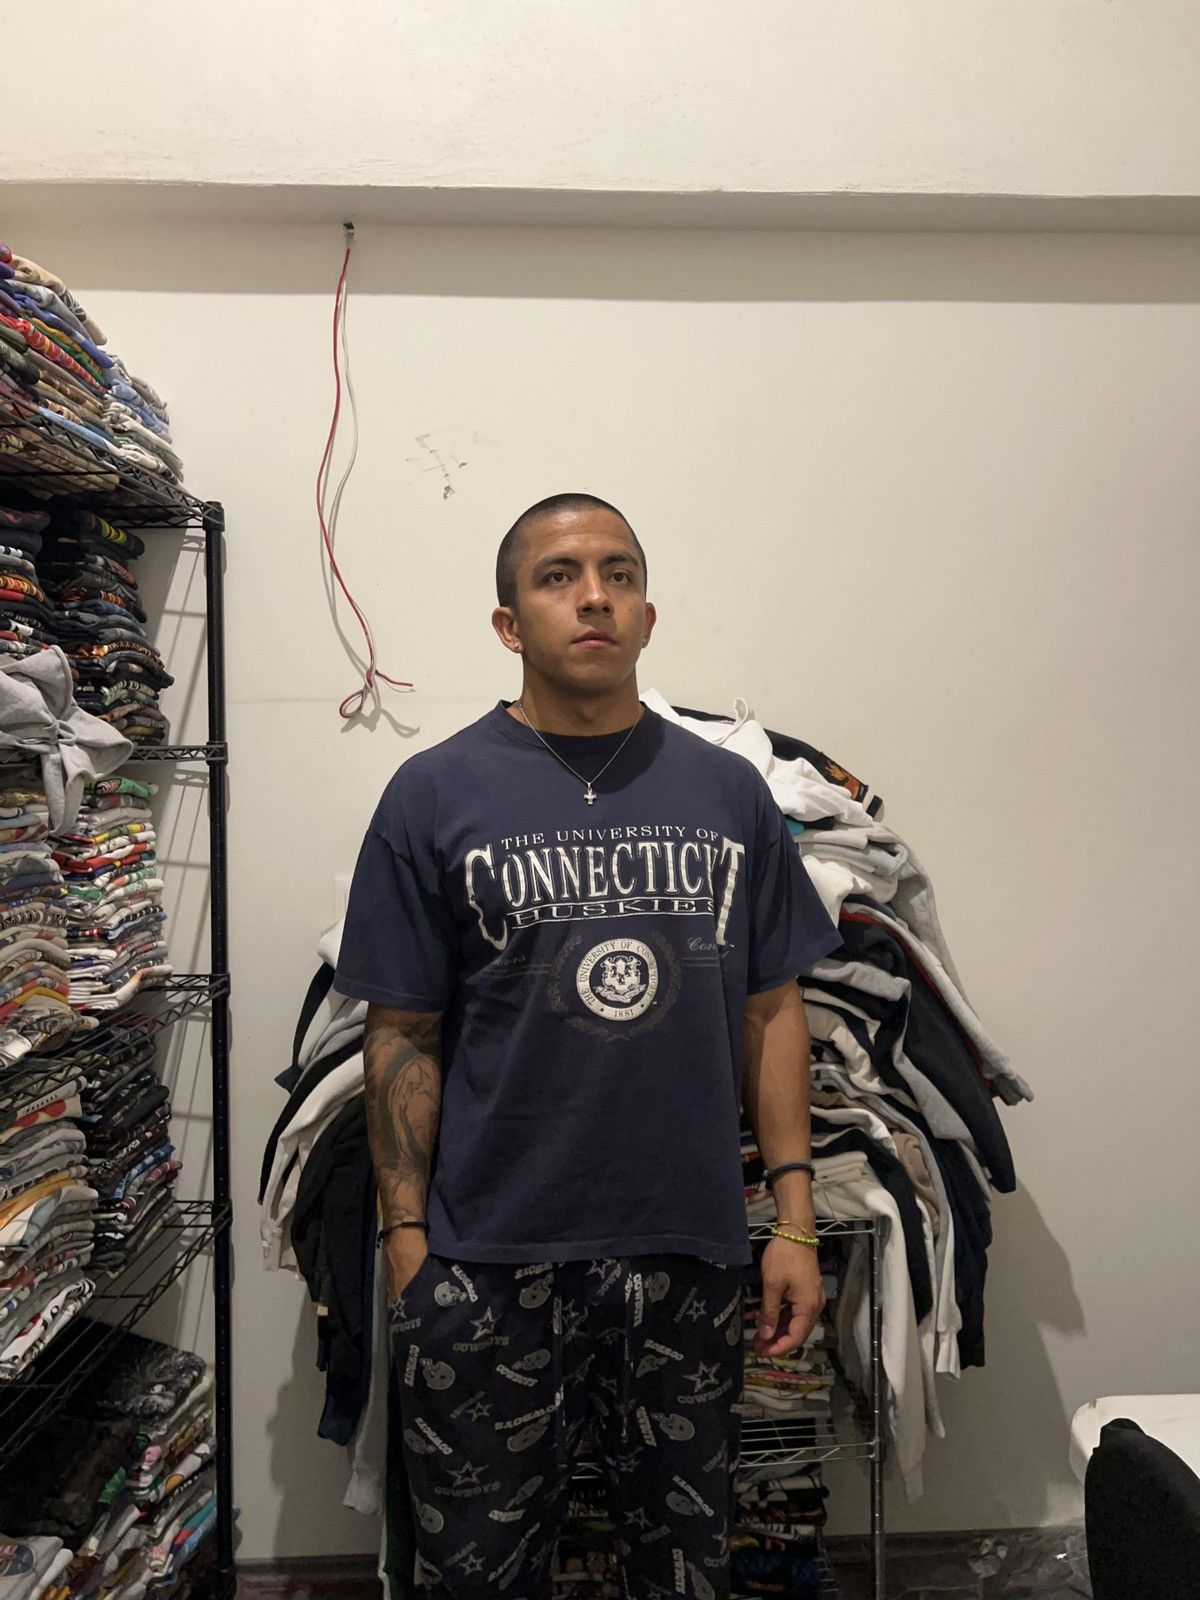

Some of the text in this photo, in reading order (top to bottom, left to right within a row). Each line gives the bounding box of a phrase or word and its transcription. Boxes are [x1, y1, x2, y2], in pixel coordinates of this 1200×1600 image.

[501, 825, 719, 850] THE UNIVERSITY OF
[579, 941, 657, 1007] THE UNIVERSITY OF CONNTICUT
[614, 1008, 634, 1018] 1881
